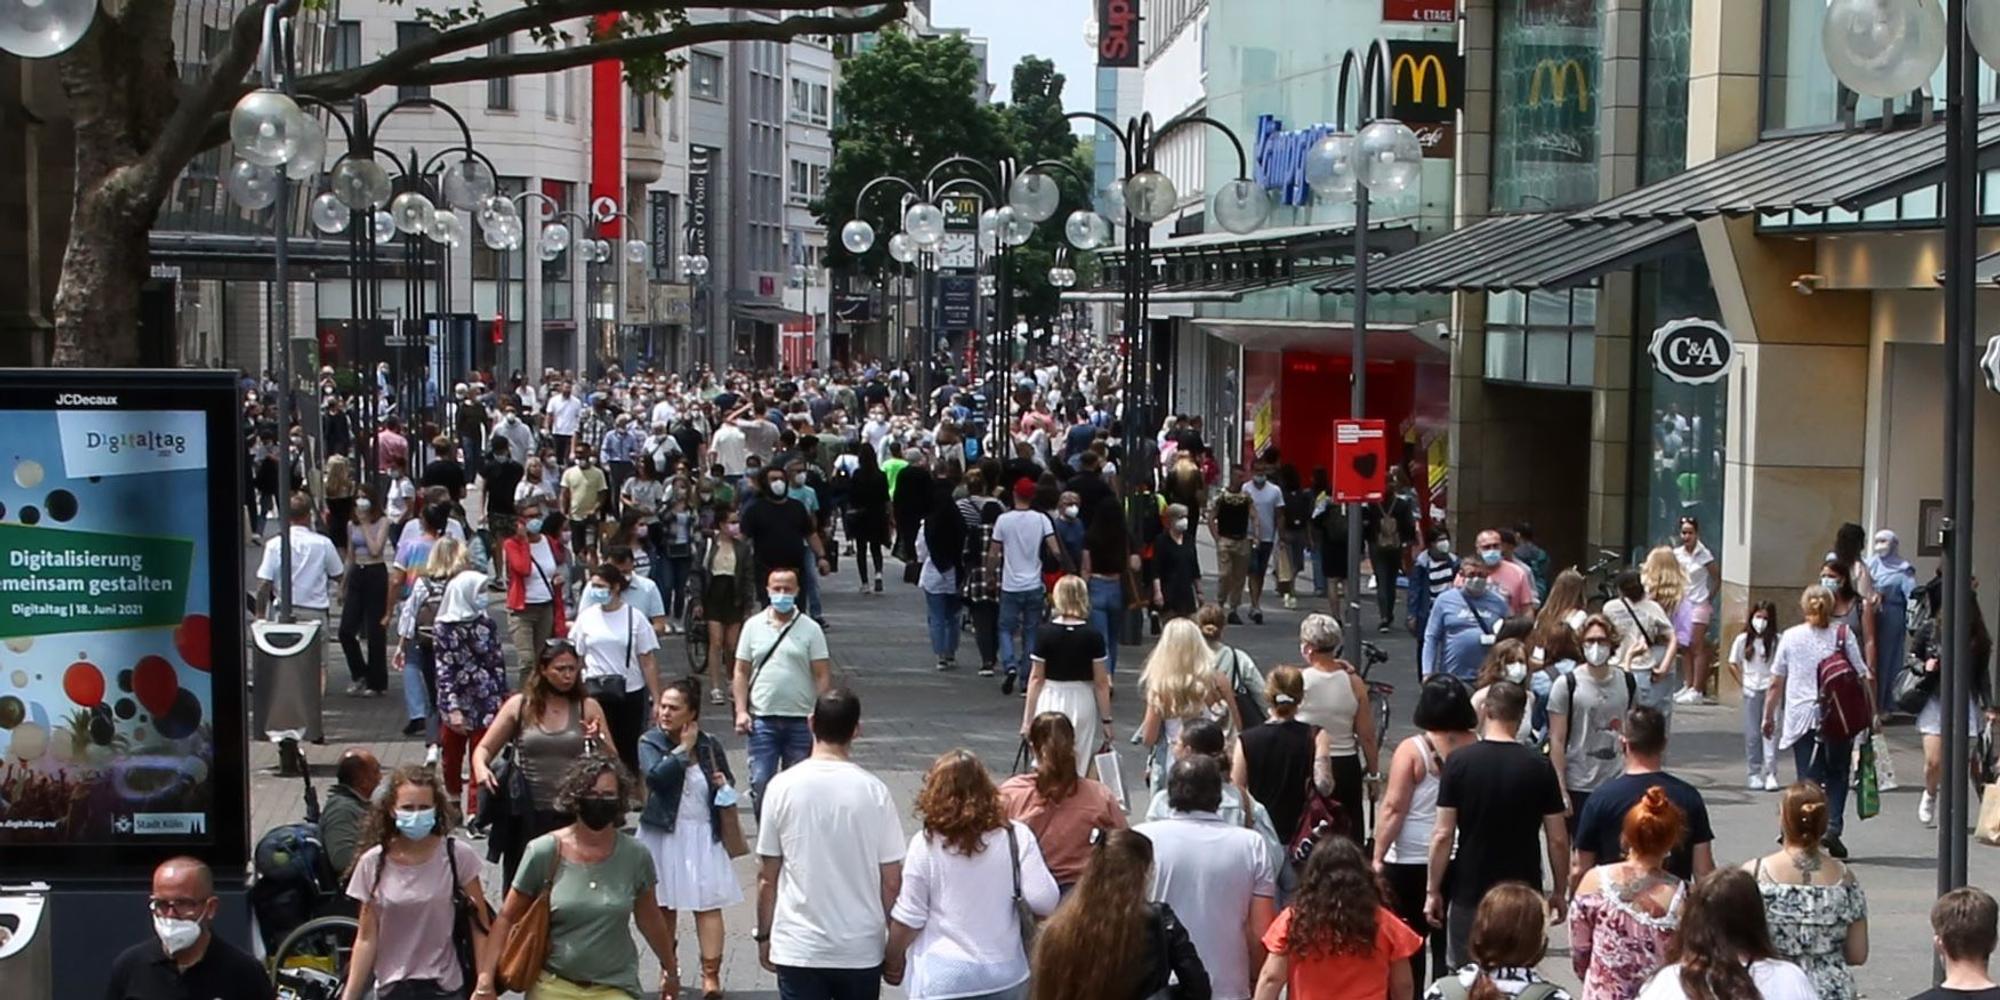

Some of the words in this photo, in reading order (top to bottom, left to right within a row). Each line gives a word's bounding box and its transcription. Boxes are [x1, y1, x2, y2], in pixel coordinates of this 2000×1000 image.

[1424, 9, 1451, 21] ETAGE
[1669, 337, 1722, 365] C&A
[56, 394, 118, 406] JCDecaux
[10, 550, 142, 571] Digitalisierung
[89, 576, 172, 596] gestalten
[12, 604, 67, 617] Digitaltag
[76, 604, 91, 614] 18.
[93, 604, 116, 614] Juni
[118, 604, 143, 614] 2021
